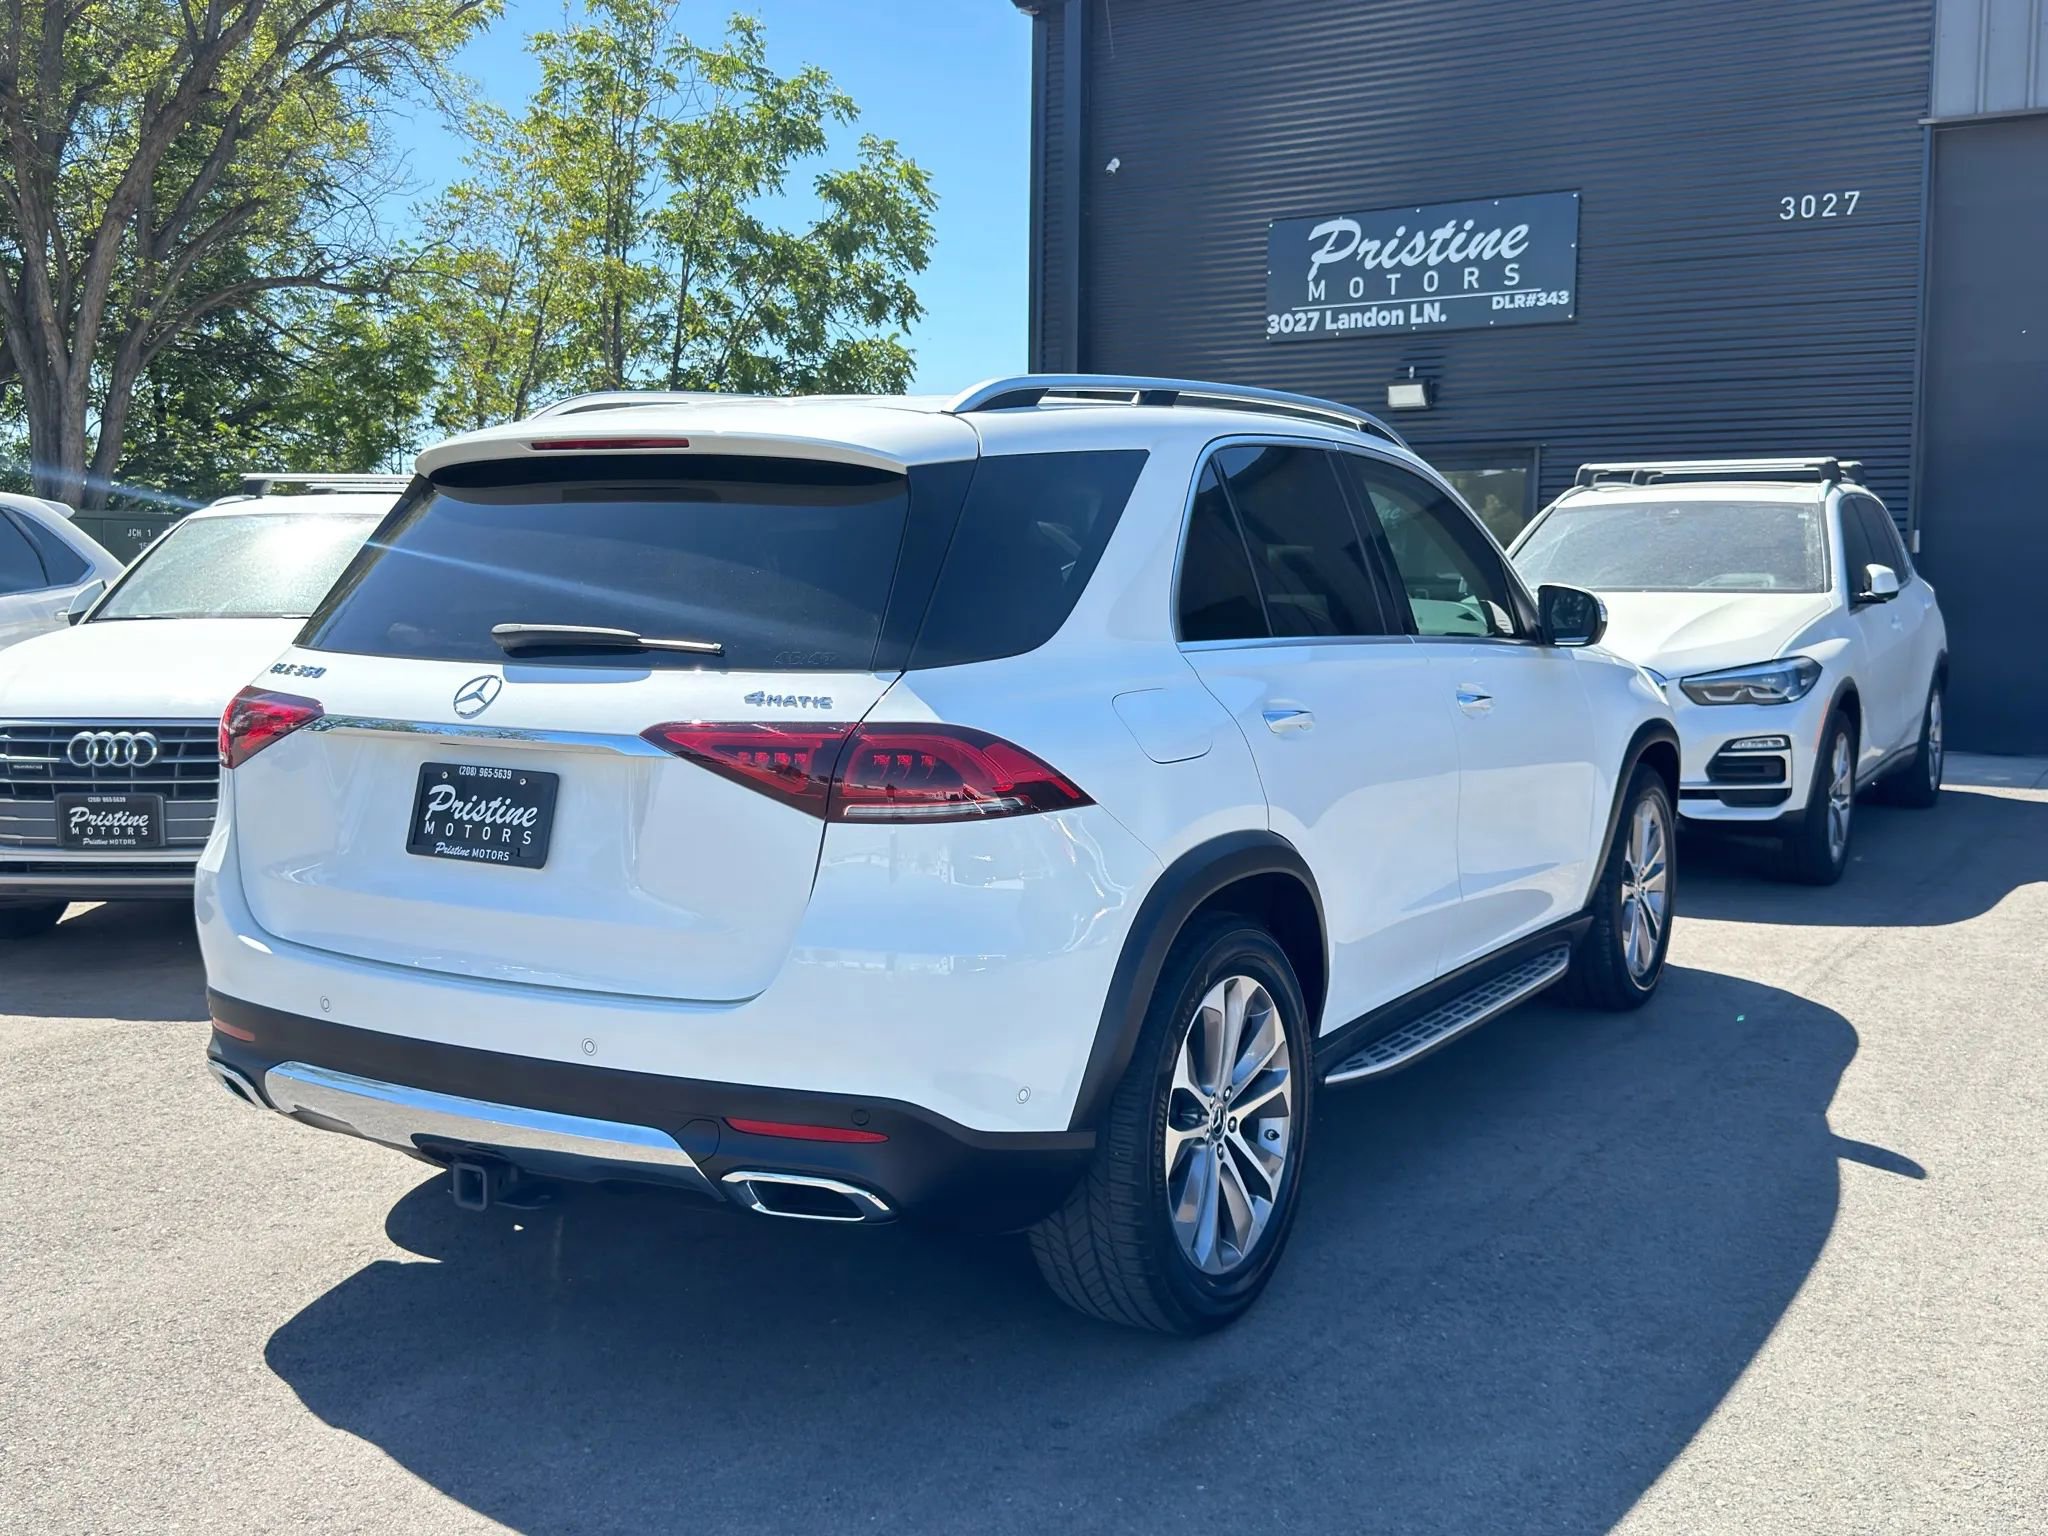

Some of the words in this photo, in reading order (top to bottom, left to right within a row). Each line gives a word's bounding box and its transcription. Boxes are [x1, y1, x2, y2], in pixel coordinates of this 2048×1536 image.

[1779, 190, 1860, 220] 3027
[1307, 218, 1530, 281] Pristine
[1307, 263, 1520, 301] MOTORS
[1491, 290, 1569, 311] DLR#343
[1266, 311, 1319, 335] 3027
[1325, 305, 1405, 330] Landon
[1410, 302, 1447, 325] LN.
[743, 690, 834, 710] 4MATIC
[458, 765, 477, 777] (208)
[479, 768, 512, 780] 965-5639
[69, 806, 150, 828] Pristine
[424, 784, 538, 828] Pristine
[71, 826, 148, 836] MOTORS
[109, 838, 136, 846] MOTORS
[424, 820, 532, 845] MOTORS
[434, 841, 470, 857] Pristine
[471, 847, 510, 861] MOTORS
